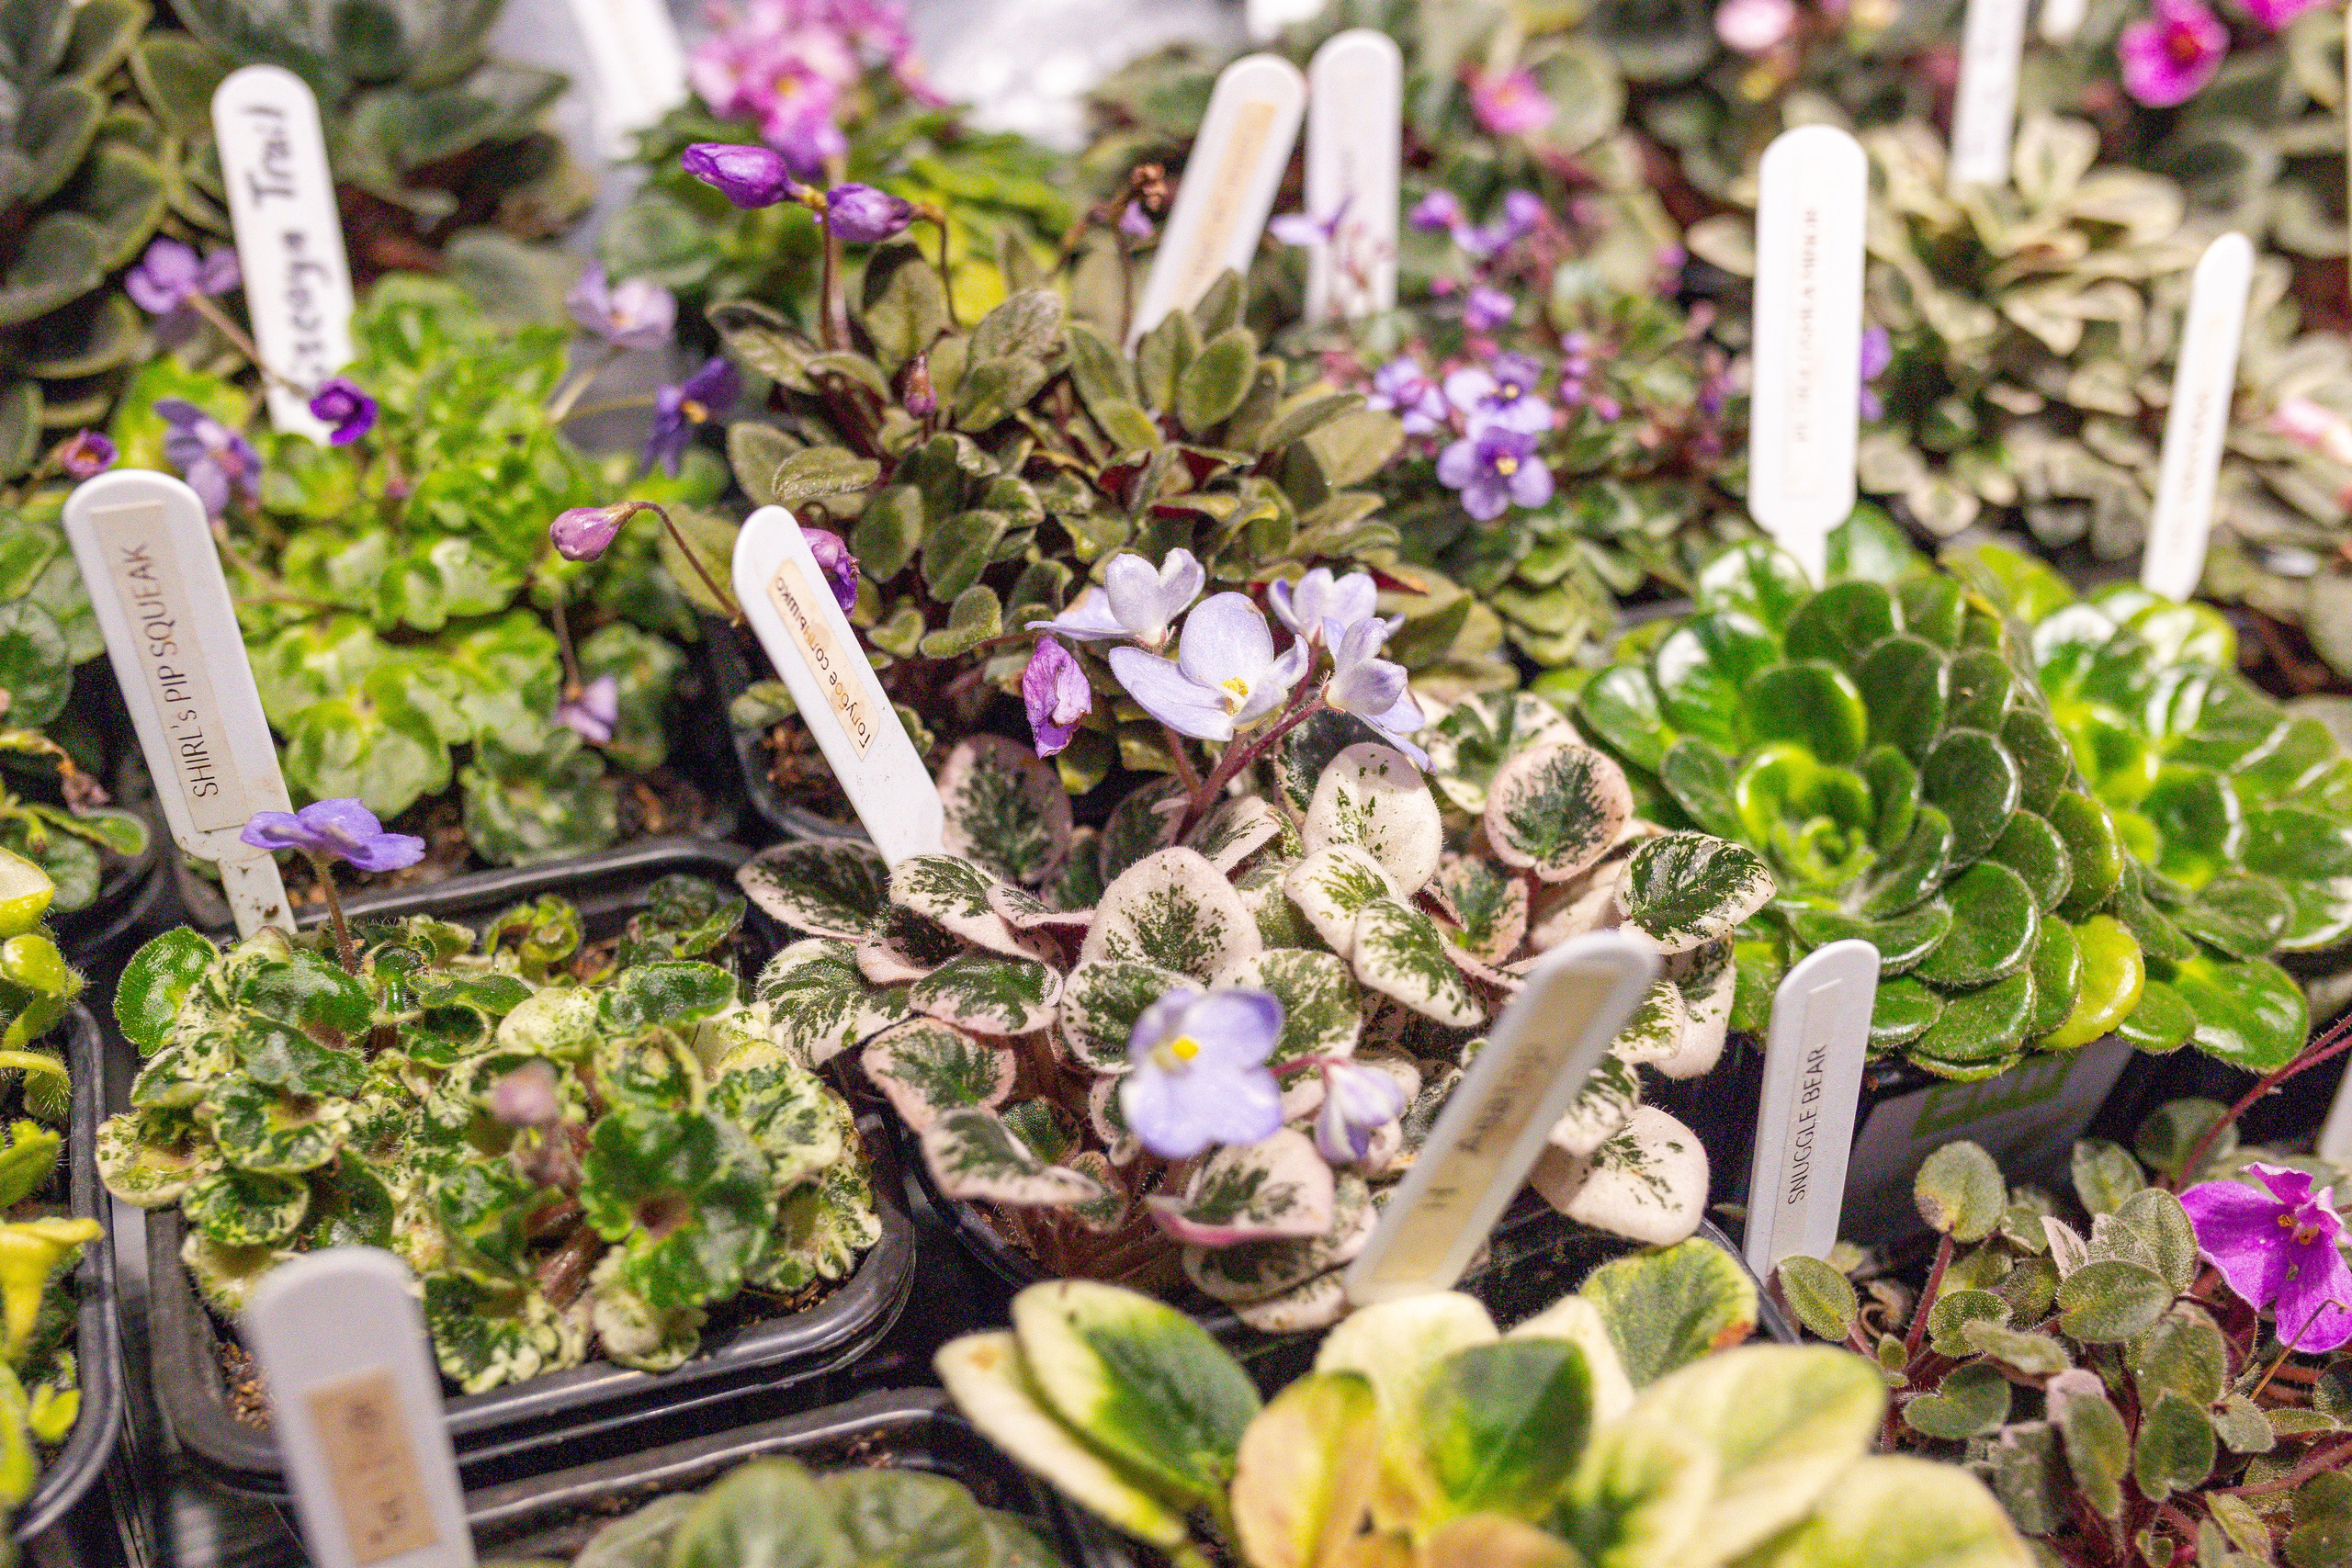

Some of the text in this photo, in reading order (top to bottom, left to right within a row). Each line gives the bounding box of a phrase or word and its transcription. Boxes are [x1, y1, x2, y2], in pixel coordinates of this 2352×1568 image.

[242, 105, 297, 210] Trail
[122, 542, 219, 798] SHIRL's PIP SQUEAK
[775, 577, 870, 749] Голубое солнышко
[1787, 1044, 1826, 1205] SNUGGLE BEAR
